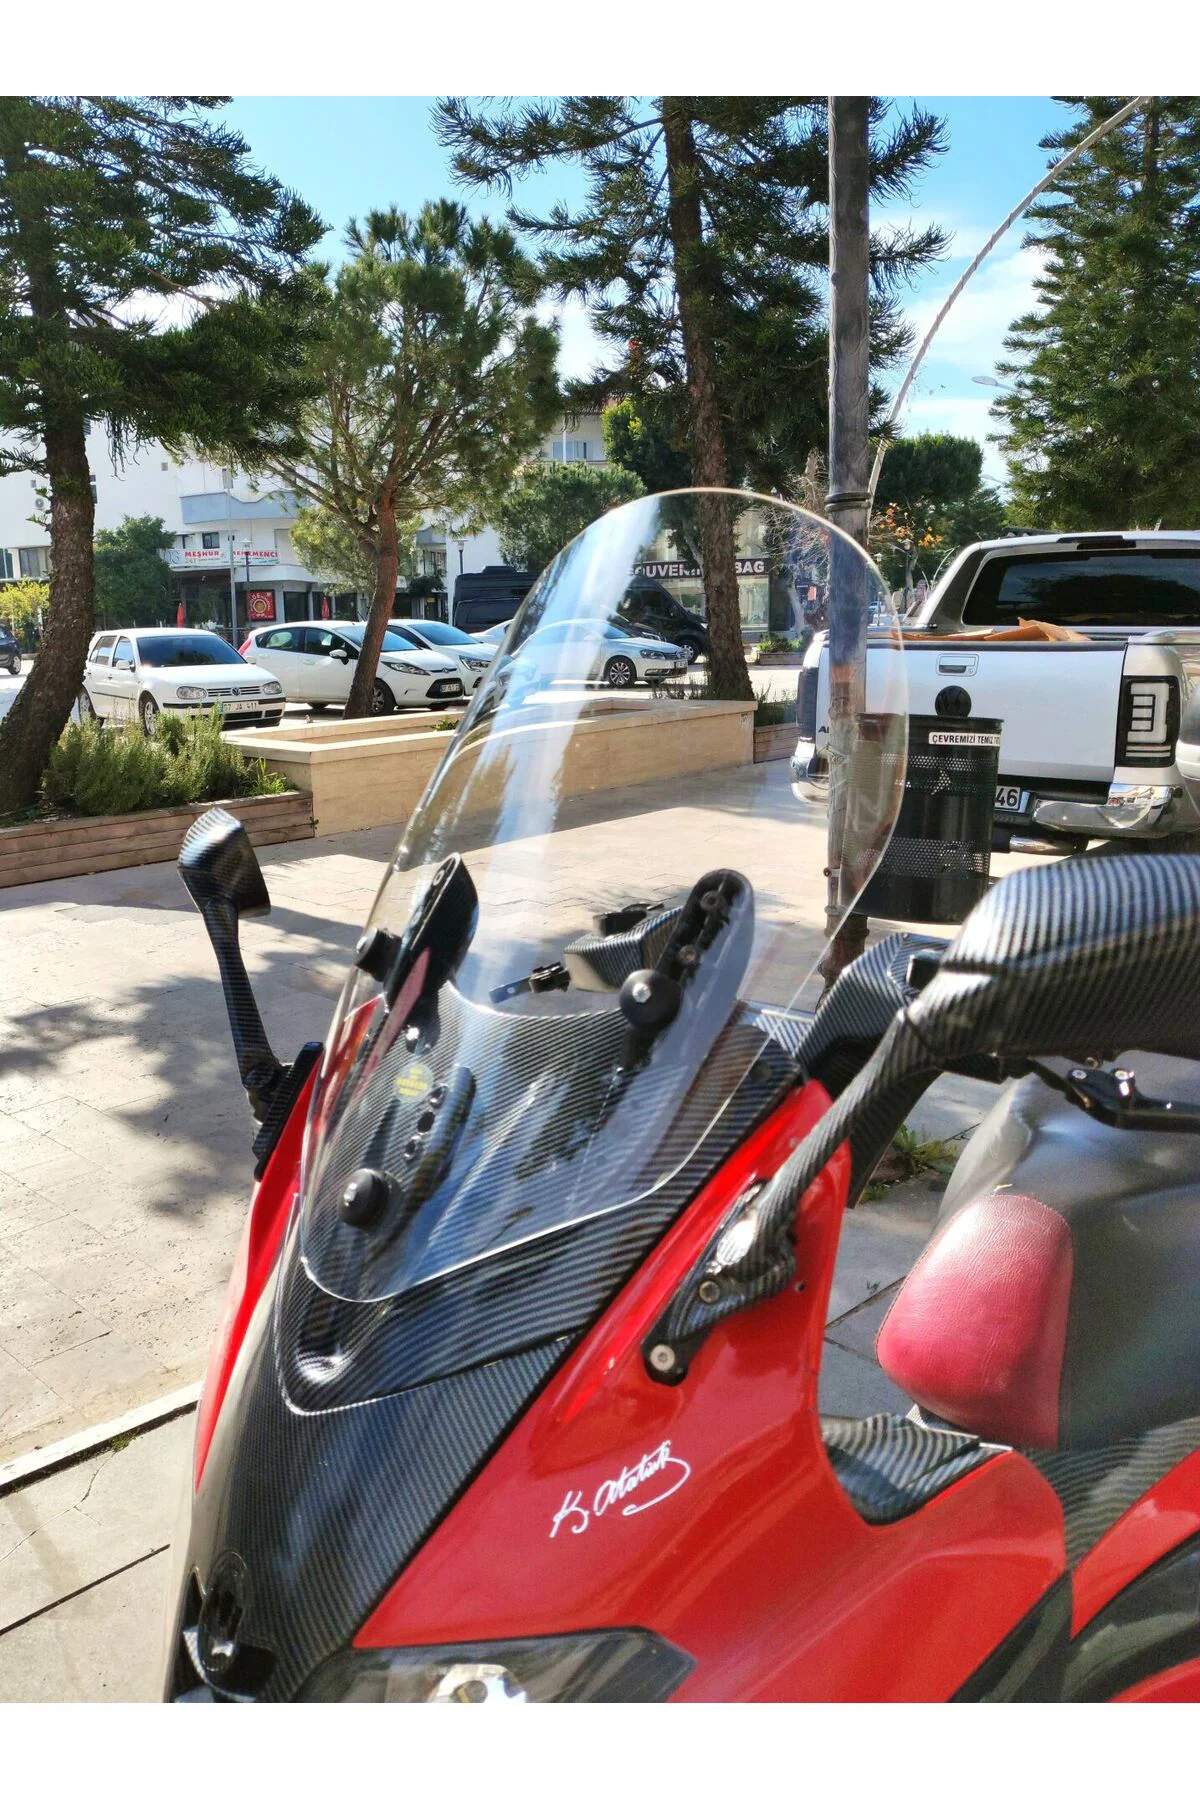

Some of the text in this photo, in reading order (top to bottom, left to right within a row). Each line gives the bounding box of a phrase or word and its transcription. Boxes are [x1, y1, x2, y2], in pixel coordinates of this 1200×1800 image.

[735, 560, 765, 574] BAG
[932, 733, 976, 744] ÇEVREMİZİ
[995, 787, 1019, 808] 46
